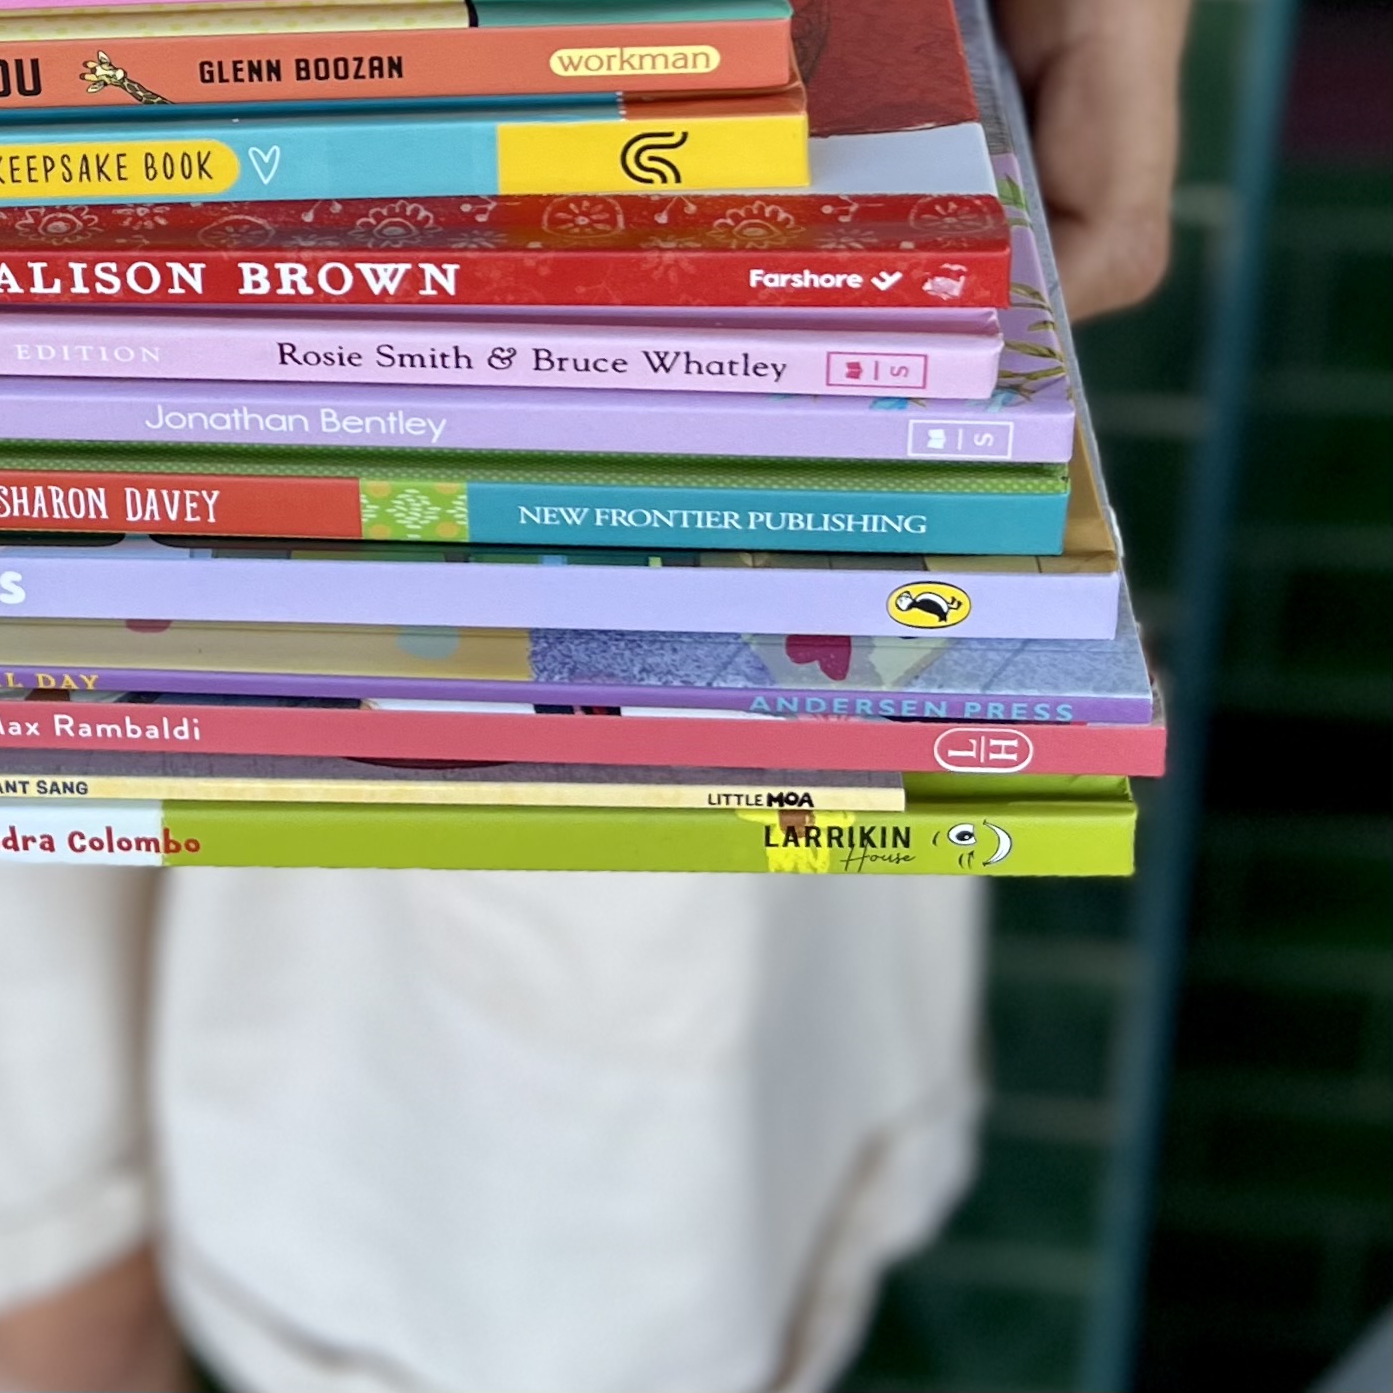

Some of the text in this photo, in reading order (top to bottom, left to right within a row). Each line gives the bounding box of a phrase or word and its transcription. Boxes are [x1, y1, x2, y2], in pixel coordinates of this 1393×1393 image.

[198, 55, 404, 84] GLENN BOOZAN
[556, 47, 711, 74] workman
[144, 149, 214, 181] BOOK
[238, 262, 460, 296] BROWN
[749, 268, 863, 289] Farshore
[15, 343, 161, 364] EDITION
[277, 342, 787, 382] Rosie Smith & Bruce Whatley
[145, 404, 447, 443] Jonathan Bentley
[125, 487, 220, 523] DAVEY
[519, 505, 927, 534] NEW FRONTIER PUBLISHING
[35, 673, 100, 691] DAY
[749, 696, 1074, 721] ANDERSEN PRESS
[53, 714, 201, 741] Rambaldi
[36, 781, 88, 795] SANG
[67, 826, 201, 854] Colombo
[764, 825, 911, 850] LARRIKIN
[839, 842, 916, 873] House
